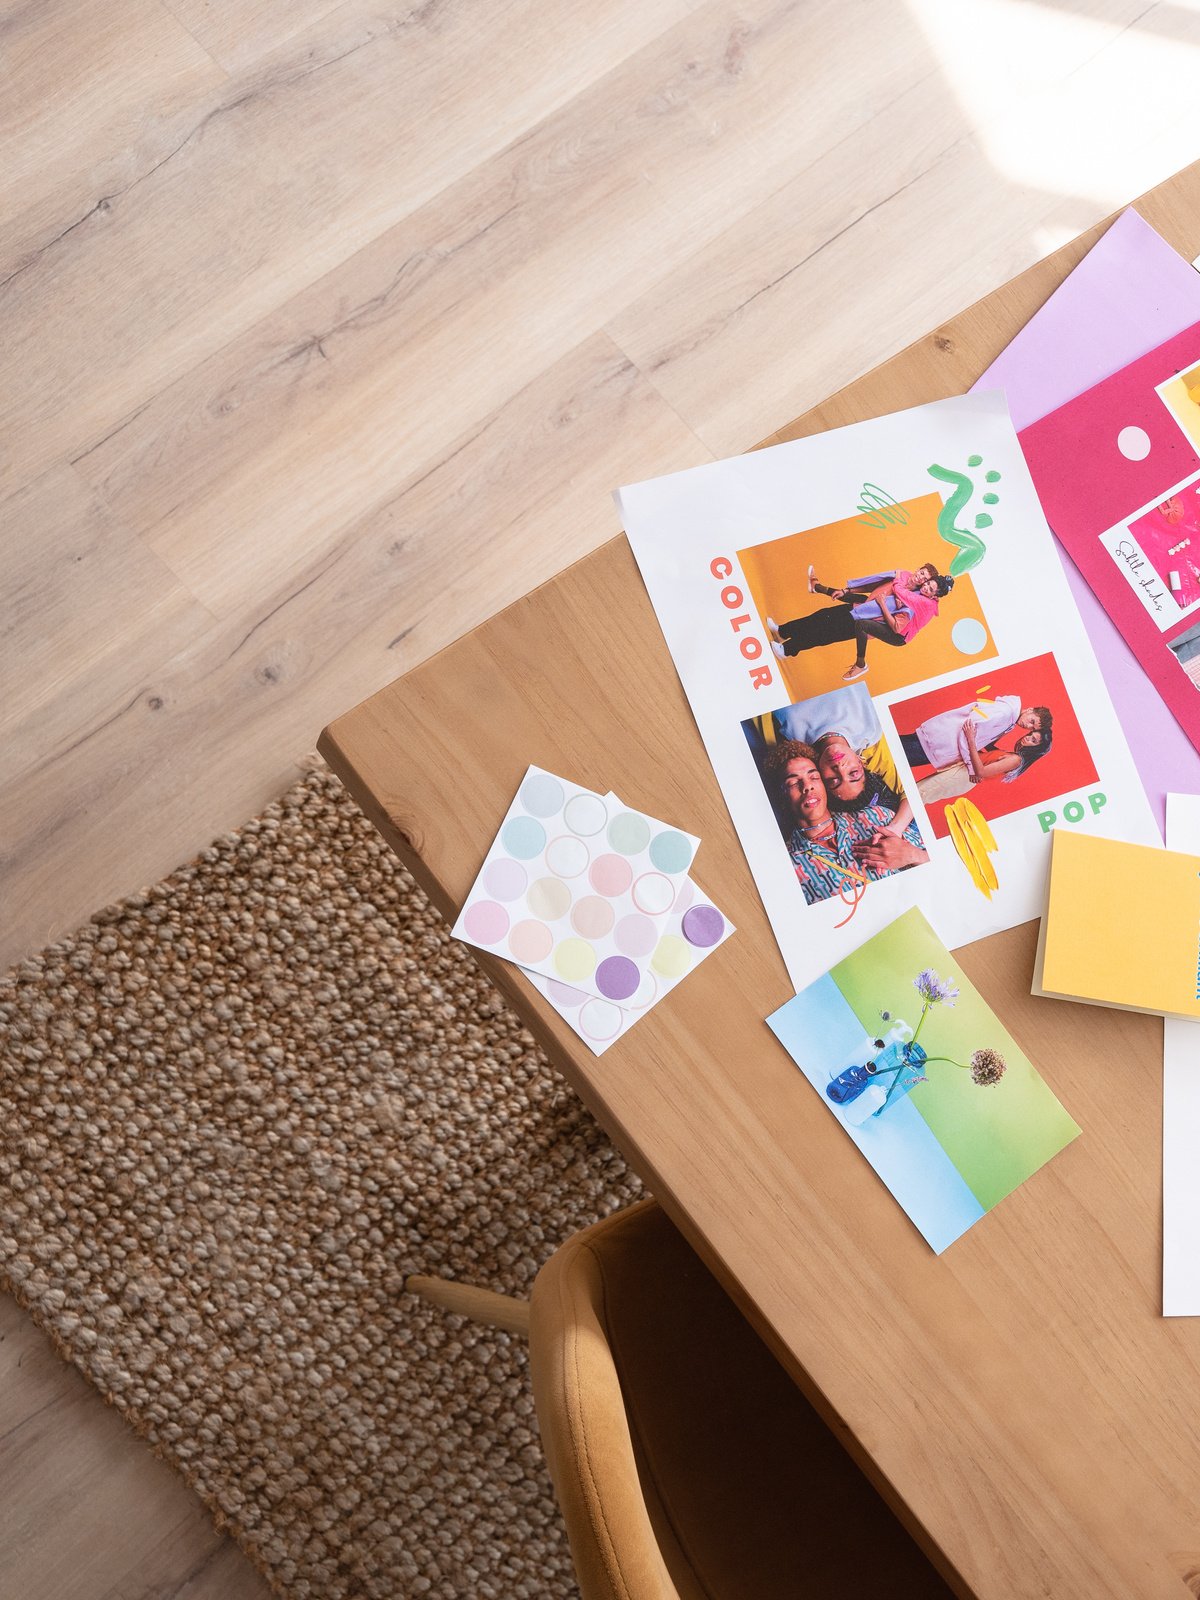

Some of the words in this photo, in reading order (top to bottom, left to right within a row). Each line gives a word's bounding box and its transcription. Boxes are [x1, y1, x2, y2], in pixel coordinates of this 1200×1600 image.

[1115, 541, 1145, 577] Subtle
[1139, 579, 1164, 611] shades
[710, 556, 773, 690] COLOR
[1037, 792, 1107, 834] POP
